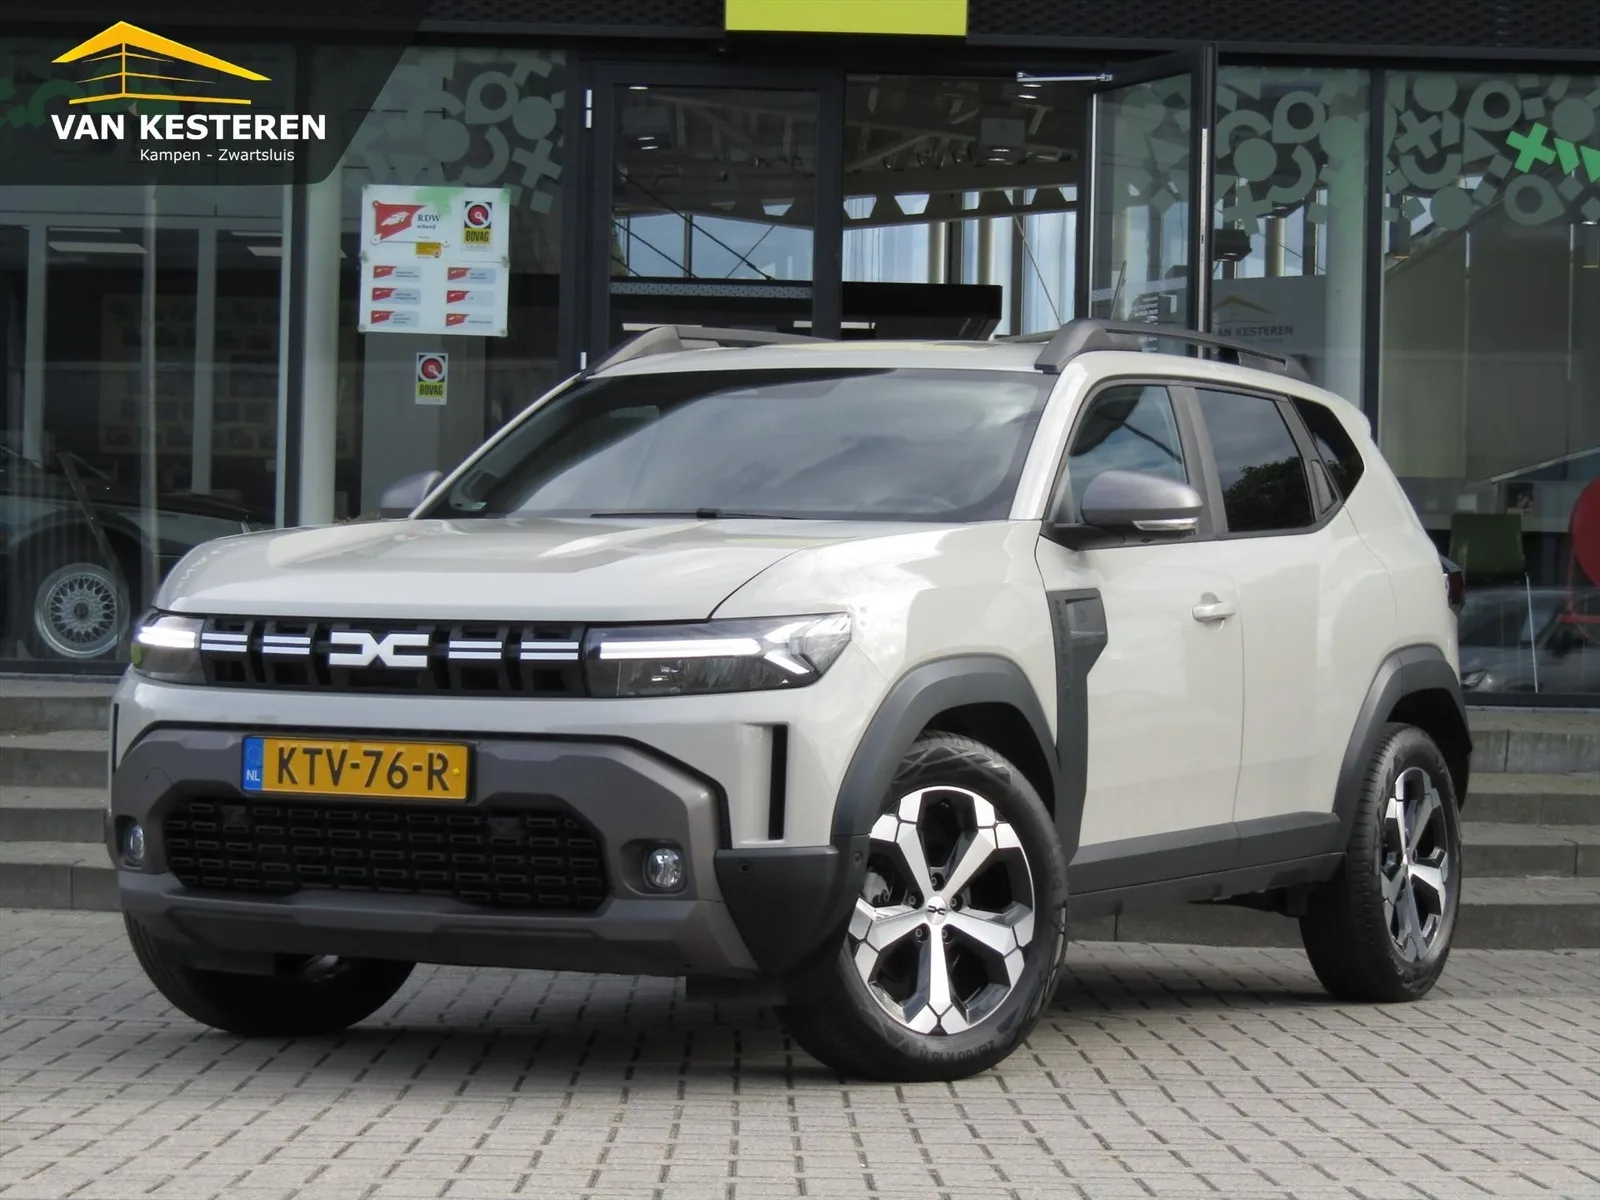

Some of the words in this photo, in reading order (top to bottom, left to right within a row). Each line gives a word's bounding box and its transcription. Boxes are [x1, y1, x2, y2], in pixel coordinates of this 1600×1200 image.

[417, 213, 441, 222] RDW
[465, 230, 490, 242] BOVAG
[1235, 325, 1294, 337] KESTEREN
[419, 384, 444, 396] BOVAG
[277, 746, 450, 791] KTV-76-R
[246, 770, 260, 782] NL
